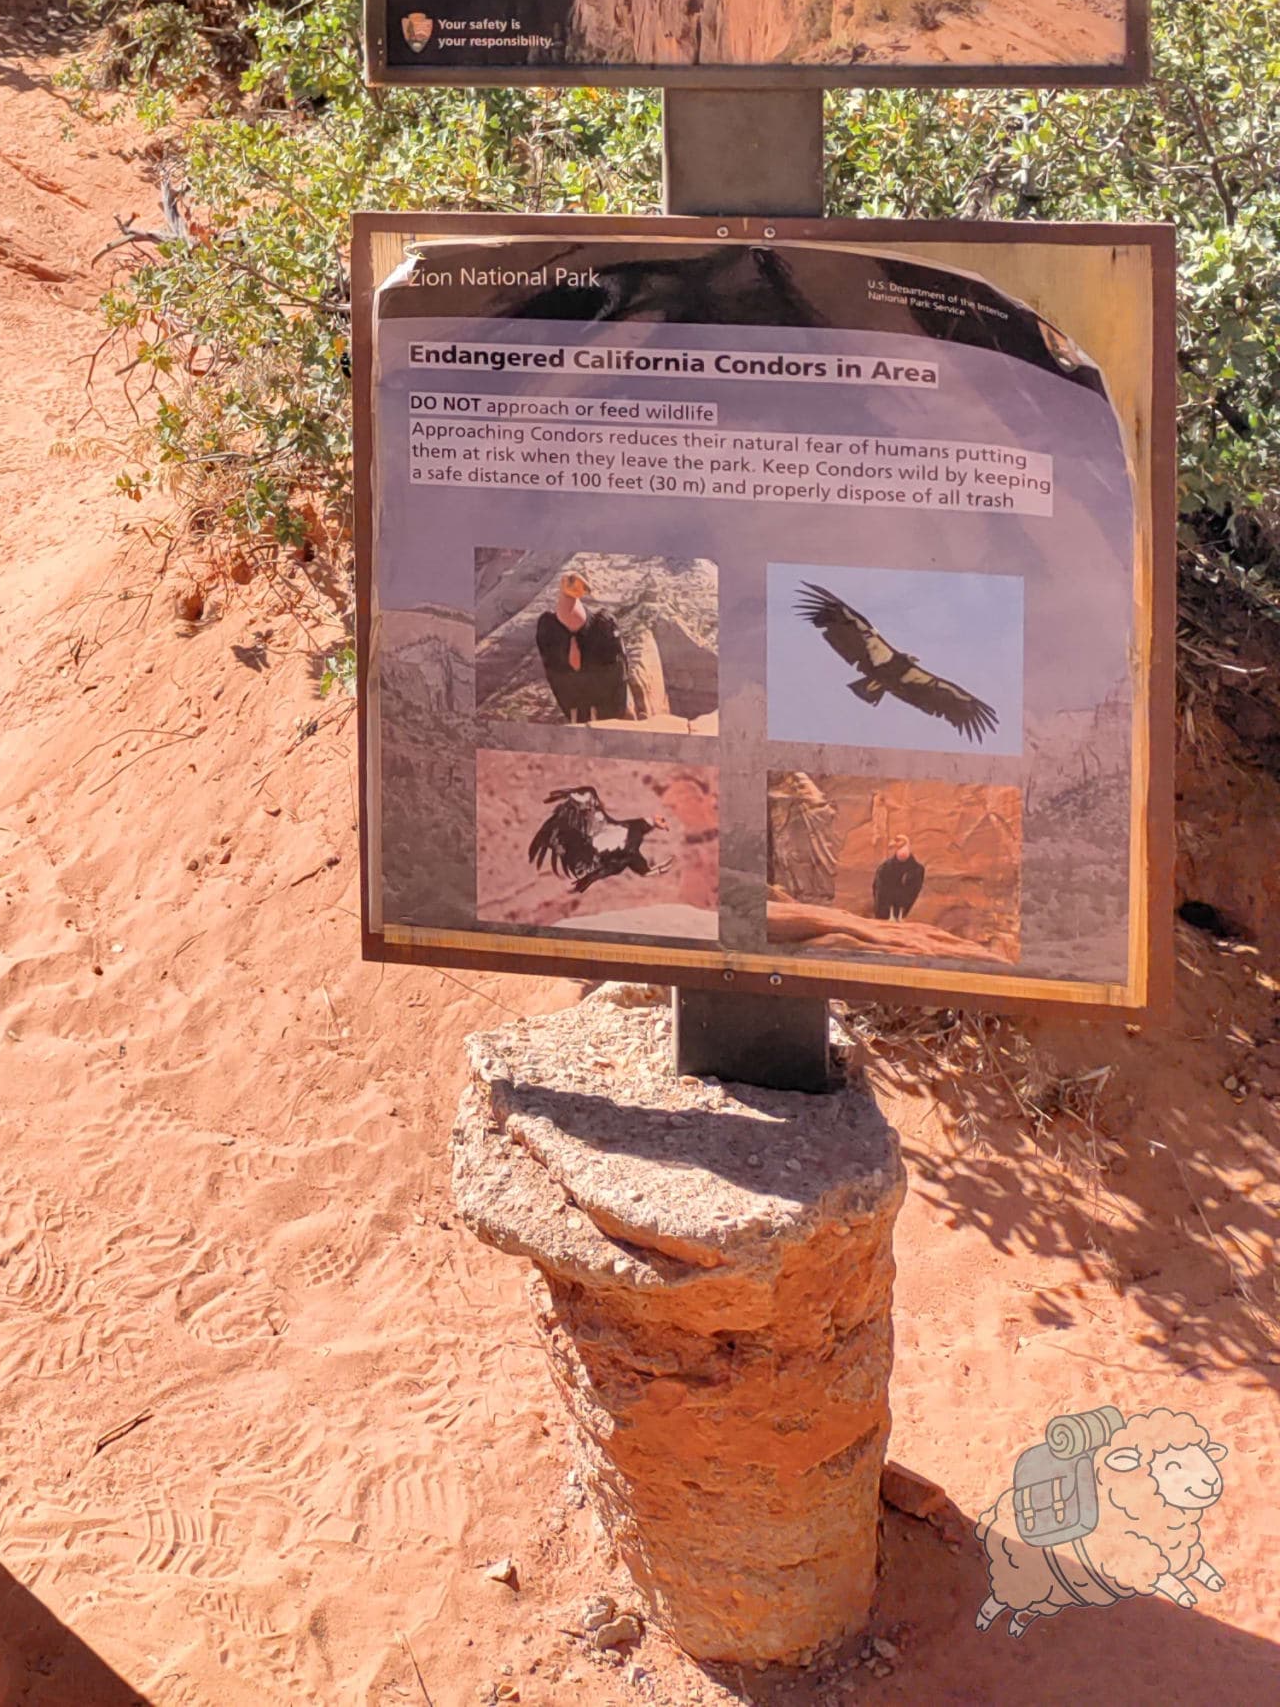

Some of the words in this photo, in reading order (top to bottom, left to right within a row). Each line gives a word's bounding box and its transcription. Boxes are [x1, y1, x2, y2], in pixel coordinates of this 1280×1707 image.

[438, 19, 466, 30] Your
[469, 18, 507, 32] safety
[511, 19, 520, 30] is
[438, 38, 465, 49] your
[470, 35, 554, 49] responsibility.
[409, 268, 453, 287] Zion
[460, 266, 548, 286] National
[554, 267, 601, 287] Park
[868, 279, 886, 290] U.S.
[889, 282, 945, 301] Department
[960, 297, 975, 308] the
[977, 302, 1008, 320] Interior
[868, 291, 907, 305] National
[910, 298, 929, 308] Park
[933, 302, 966, 316] Service
[409, 345, 565, 371] Endangered
[573, 350, 705, 373] California
[714, 355, 827, 378] Condors
[836, 359, 862, 379] in
[870, 361, 937, 384] Area
[410, 396, 437, 410] DO
[444, 397, 481, 412] NOT
[486, 400, 568, 417] approach
[575, 404, 594, 416] or
[600, 402, 640, 418] feed
[646, 404, 714, 421] wildlife
[412, 422, 524, 443] Approaching
[531, 426, 603, 444] Condors
[609, 430, 678, 446] reduces
[683, 434, 727, 449] their
[733, 435, 799, 452] natural
[806, 436, 843, 455] fear
[849, 439, 869, 455] of
[875, 440, 949, 460] humans
[956, 445, 1027, 469] putting
[412, 443, 456, 459] them
[463, 447, 480, 460] at
[486, 446, 515, 462] risk
[521, 448, 569, 464] when
[576, 450, 615, 470] they
[621, 452, 668, 468] leave
[674, 455, 703, 470] the
[710, 454, 756, 474] park.
[763, 459, 809, 478] Keep
[816, 461, 893, 480] Condors
[898, 465, 938, 482] wild
[946, 465, 968, 486] by
[974, 468, 1051, 495] keeping
[412, 467, 421, 479] a
[428, 465, 462, 481] safe
[468, 467, 540, 485] distance
[546, 470, 564, 486] of
[571, 472, 601, 487] 100
[608, 474, 642, 490] feet
[649, 475, 676, 493] (30
[683, 477, 705, 495] m)
[712, 479, 746, 494] and
[753, 481, 831, 502] properly
[837, 482, 906, 505] dispose
[912, 489, 932, 503] of
[938, 489, 960, 505] all
[967, 491, 1014, 509] trash
